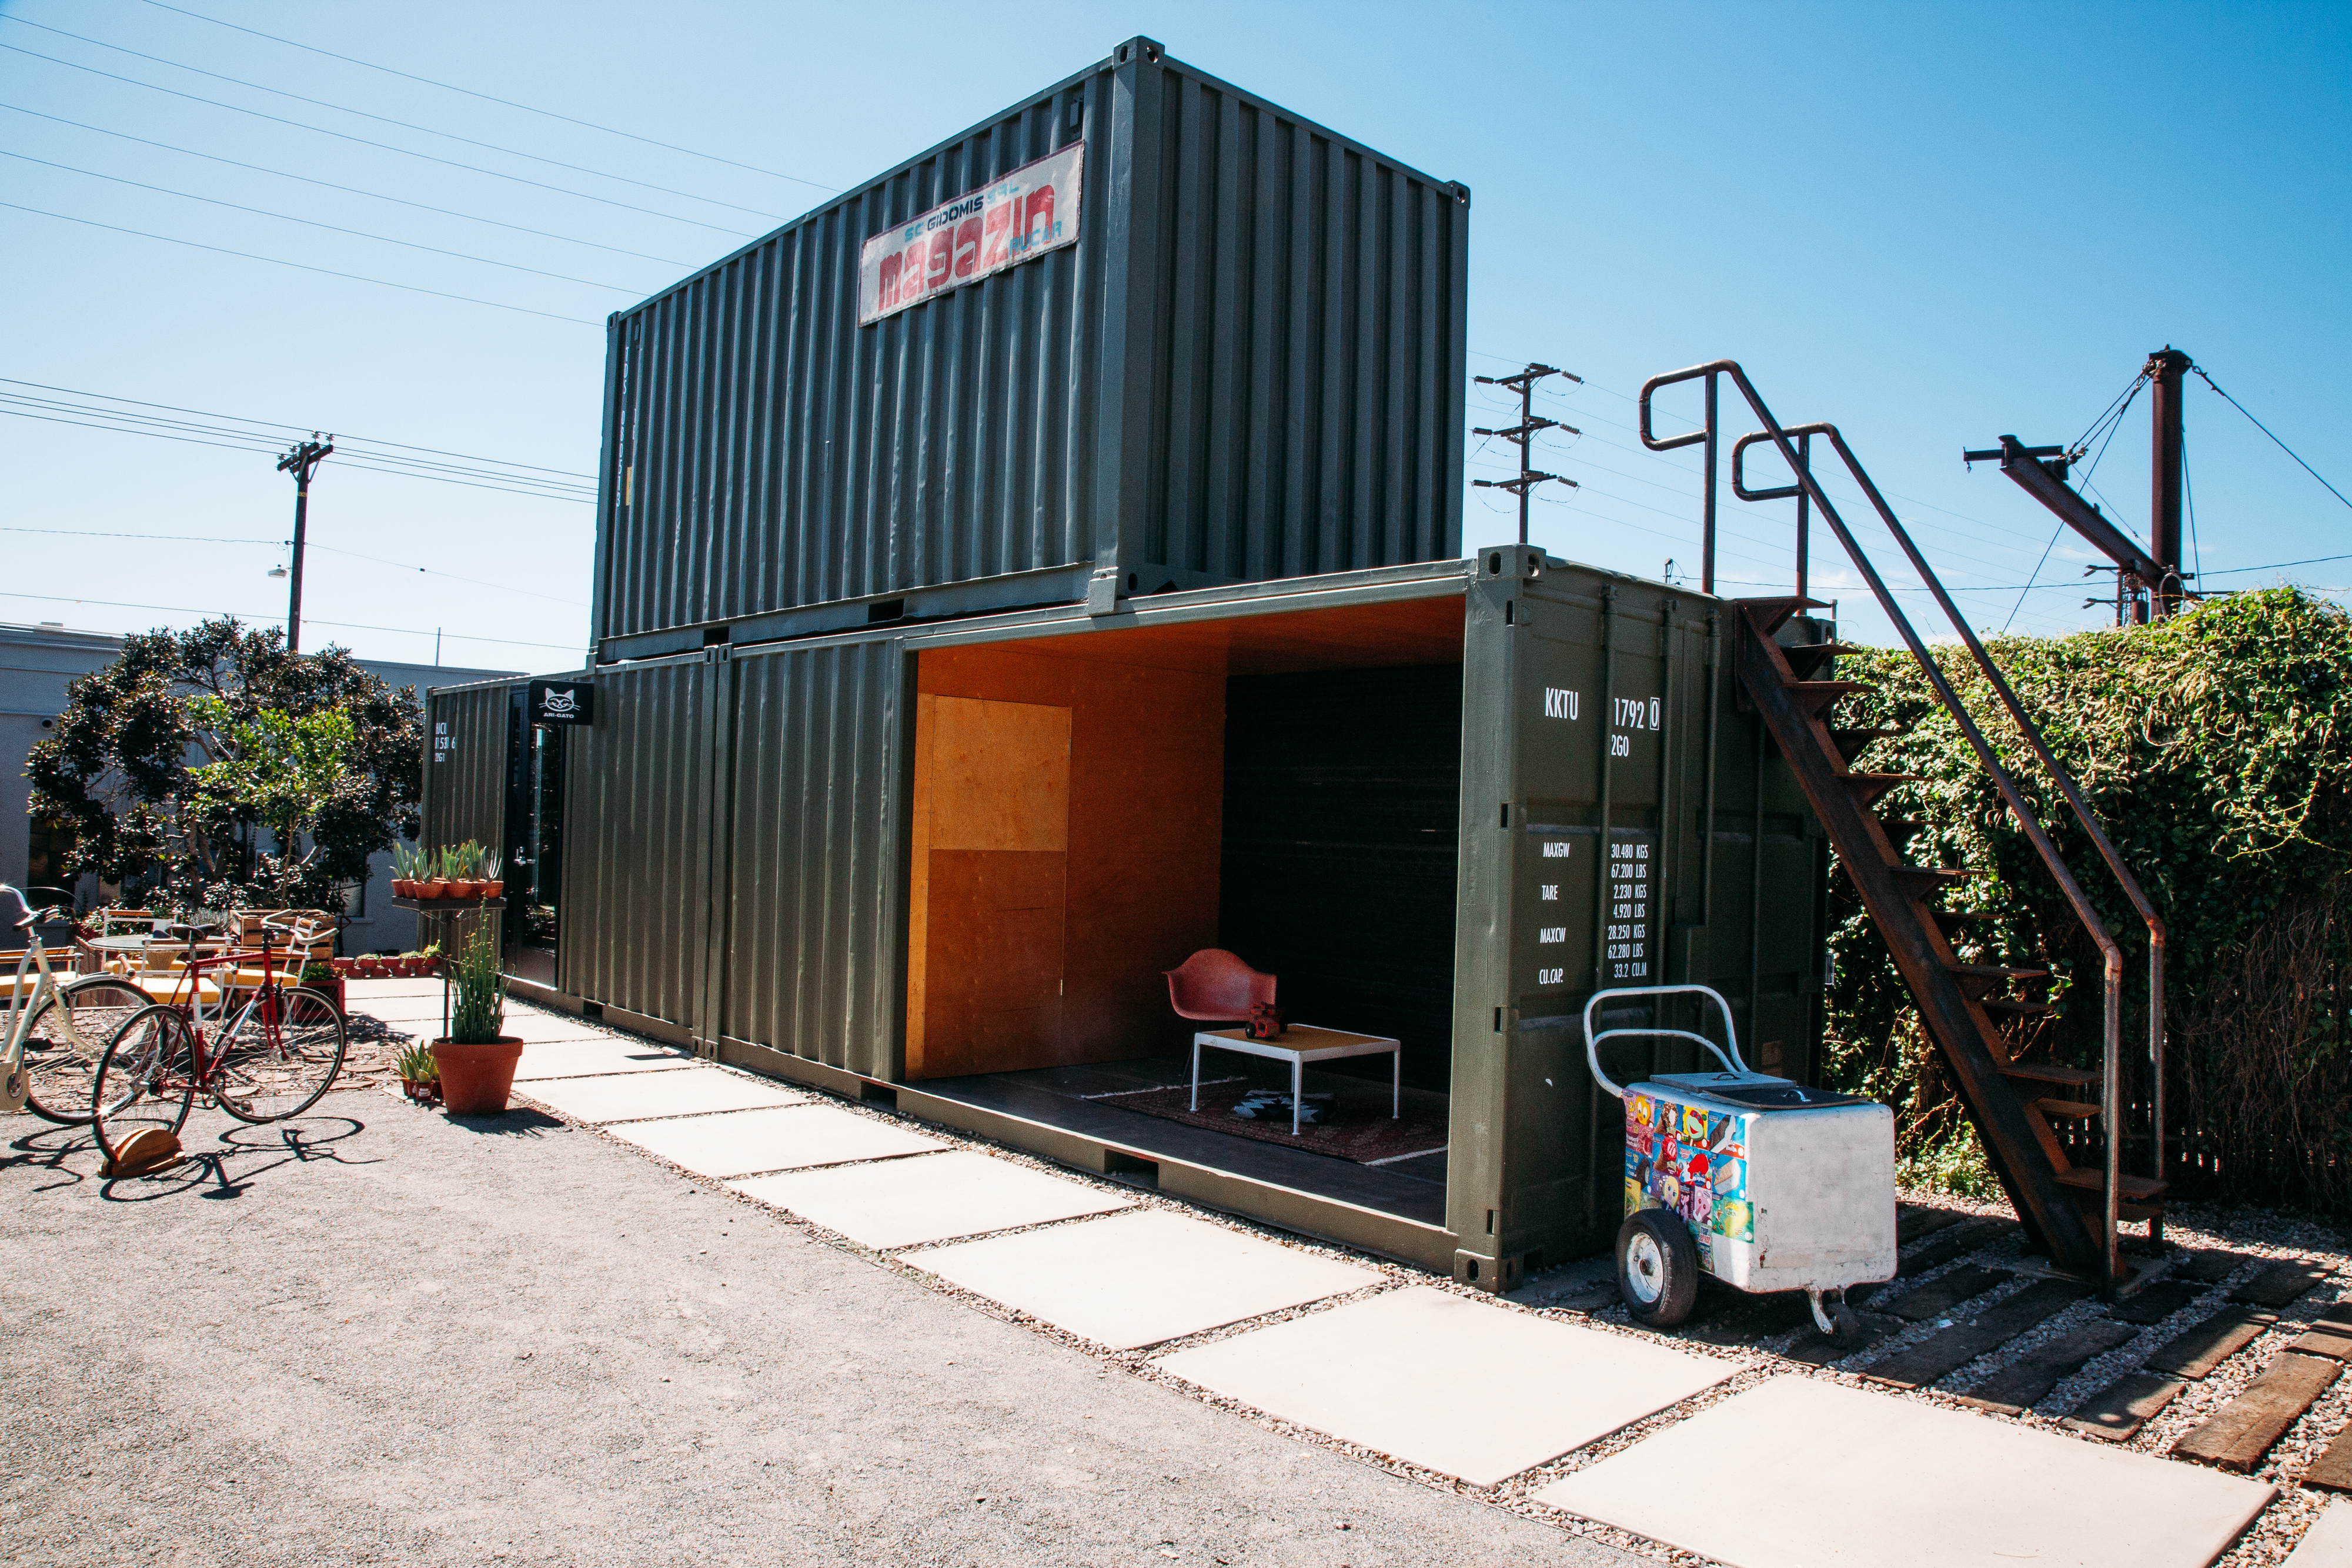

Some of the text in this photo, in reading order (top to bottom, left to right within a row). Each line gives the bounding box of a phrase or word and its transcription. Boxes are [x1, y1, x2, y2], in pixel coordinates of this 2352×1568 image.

[905, 222, 924, 243] SC
[927, 196, 984, 231] GIDOMIS
[1009, 220, 1062, 255] RUCAR
[878, 185, 1054, 312] magazin
[1545, 687, 1659, 728] KKTU 1792 0
[1543, 842, 1648, 858] MAXGW 30.480 KGS
[1611, 864, 1646, 878] 67.200 LBS
[1542, 884, 1646, 900] TARE 2.230 KGS
[1613, 903, 1645, 918] 4.920 LBS
[1540, 924, 1645, 943] MAXCW 28.250 KGS
[1608, 943, 1643, 959] 62.280 LBS
[1539, 968, 1563, 984] CU.CAP.
[1614, 964, 1628, 978] 33.2
